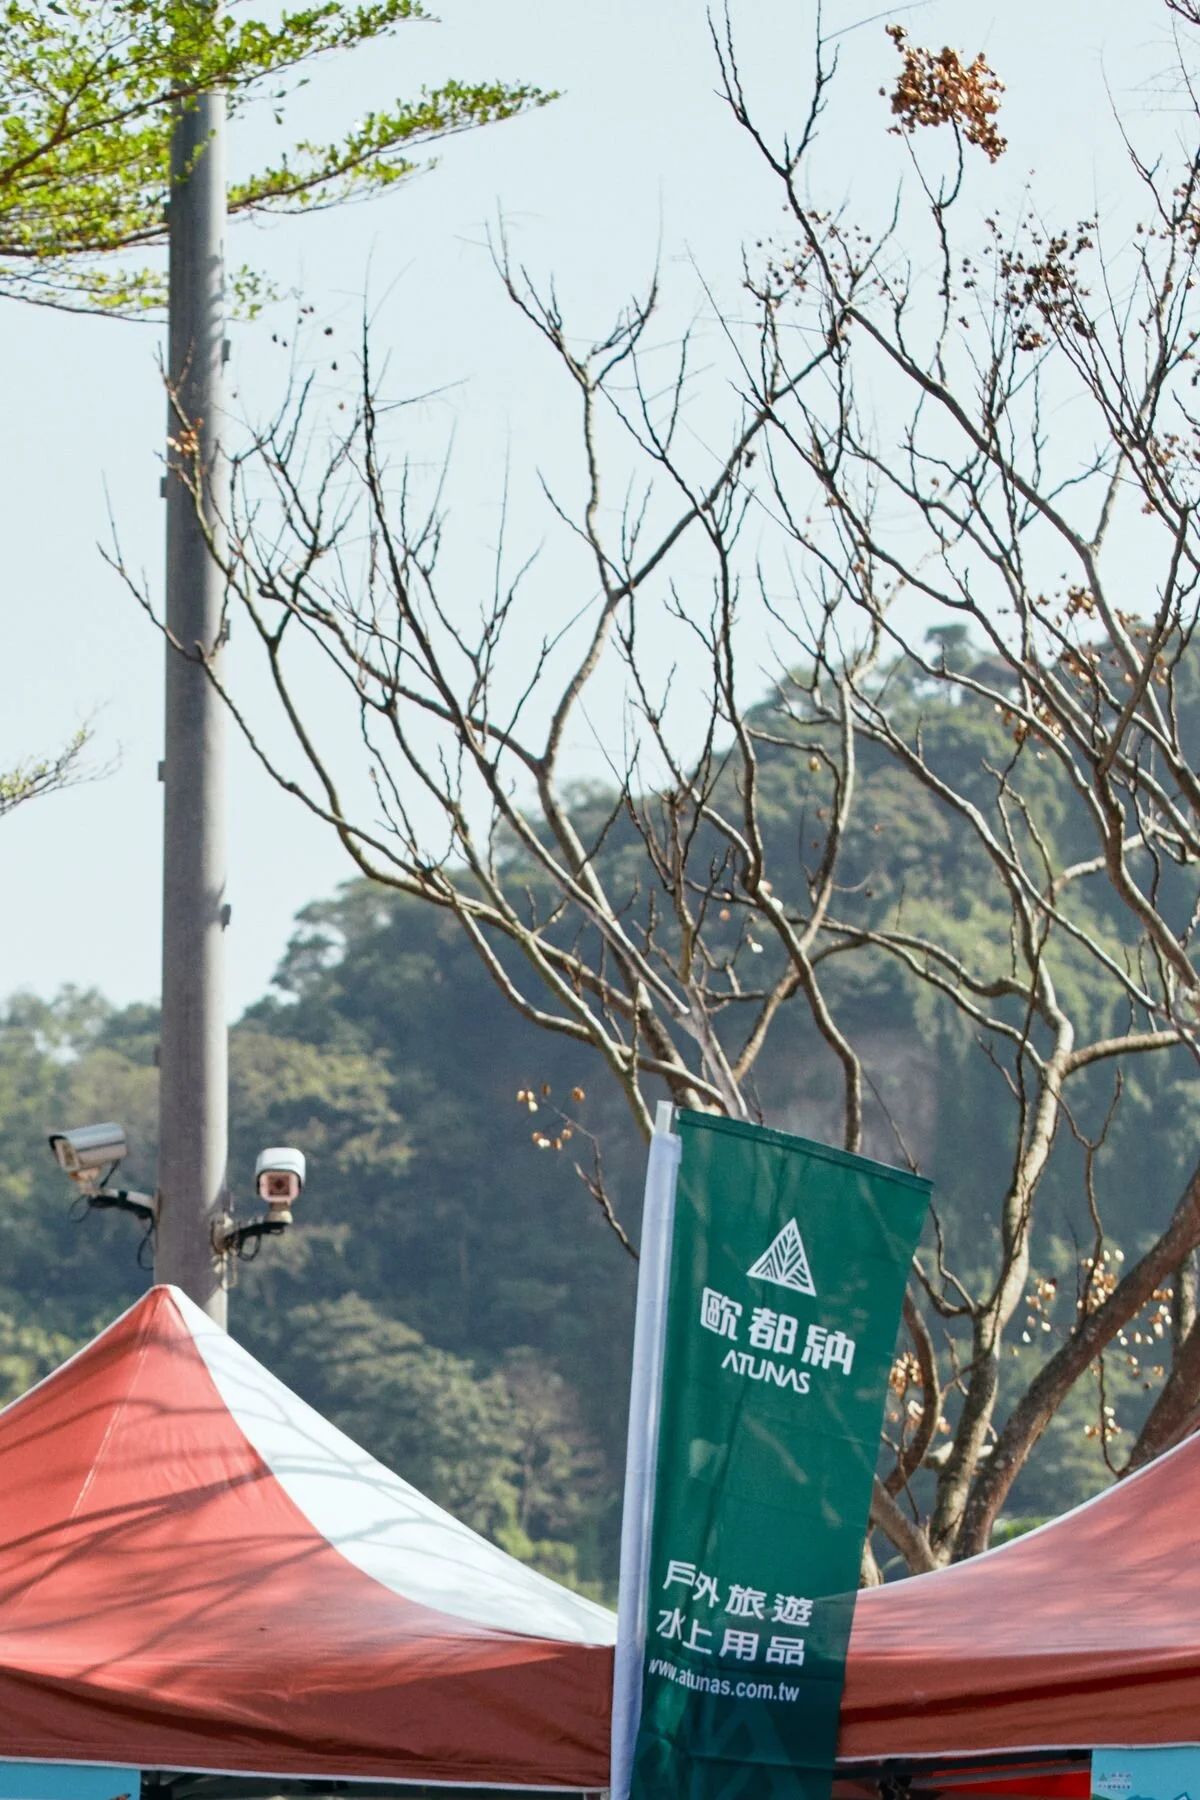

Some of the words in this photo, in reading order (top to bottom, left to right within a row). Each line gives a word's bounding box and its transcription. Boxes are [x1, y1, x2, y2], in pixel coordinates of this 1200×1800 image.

[700, 1286, 856, 1376] 歐都納
[721, 1349, 812, 1394] ATUNAS
[662, 1559, 814, 1627] 戶外旅遊
[656, 1607, 805, 1667] 水上用品
